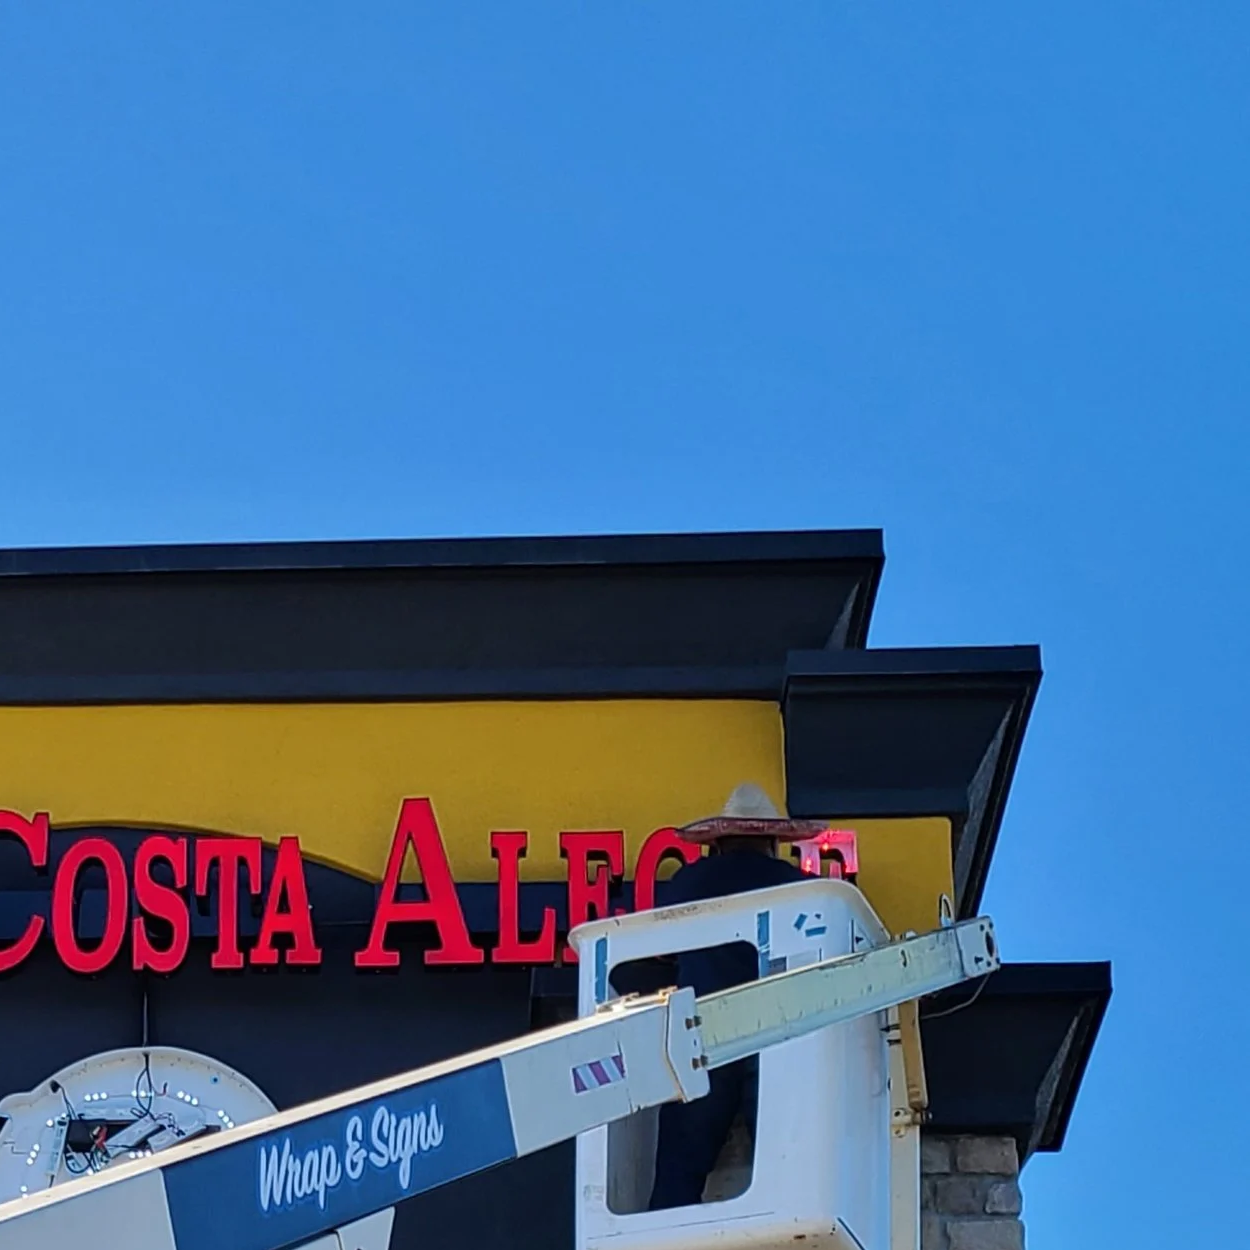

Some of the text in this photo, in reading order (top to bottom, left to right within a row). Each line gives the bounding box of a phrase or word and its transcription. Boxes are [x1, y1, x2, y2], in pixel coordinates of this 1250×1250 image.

[259, 1102, 445, 1213] Wrap & Signs
